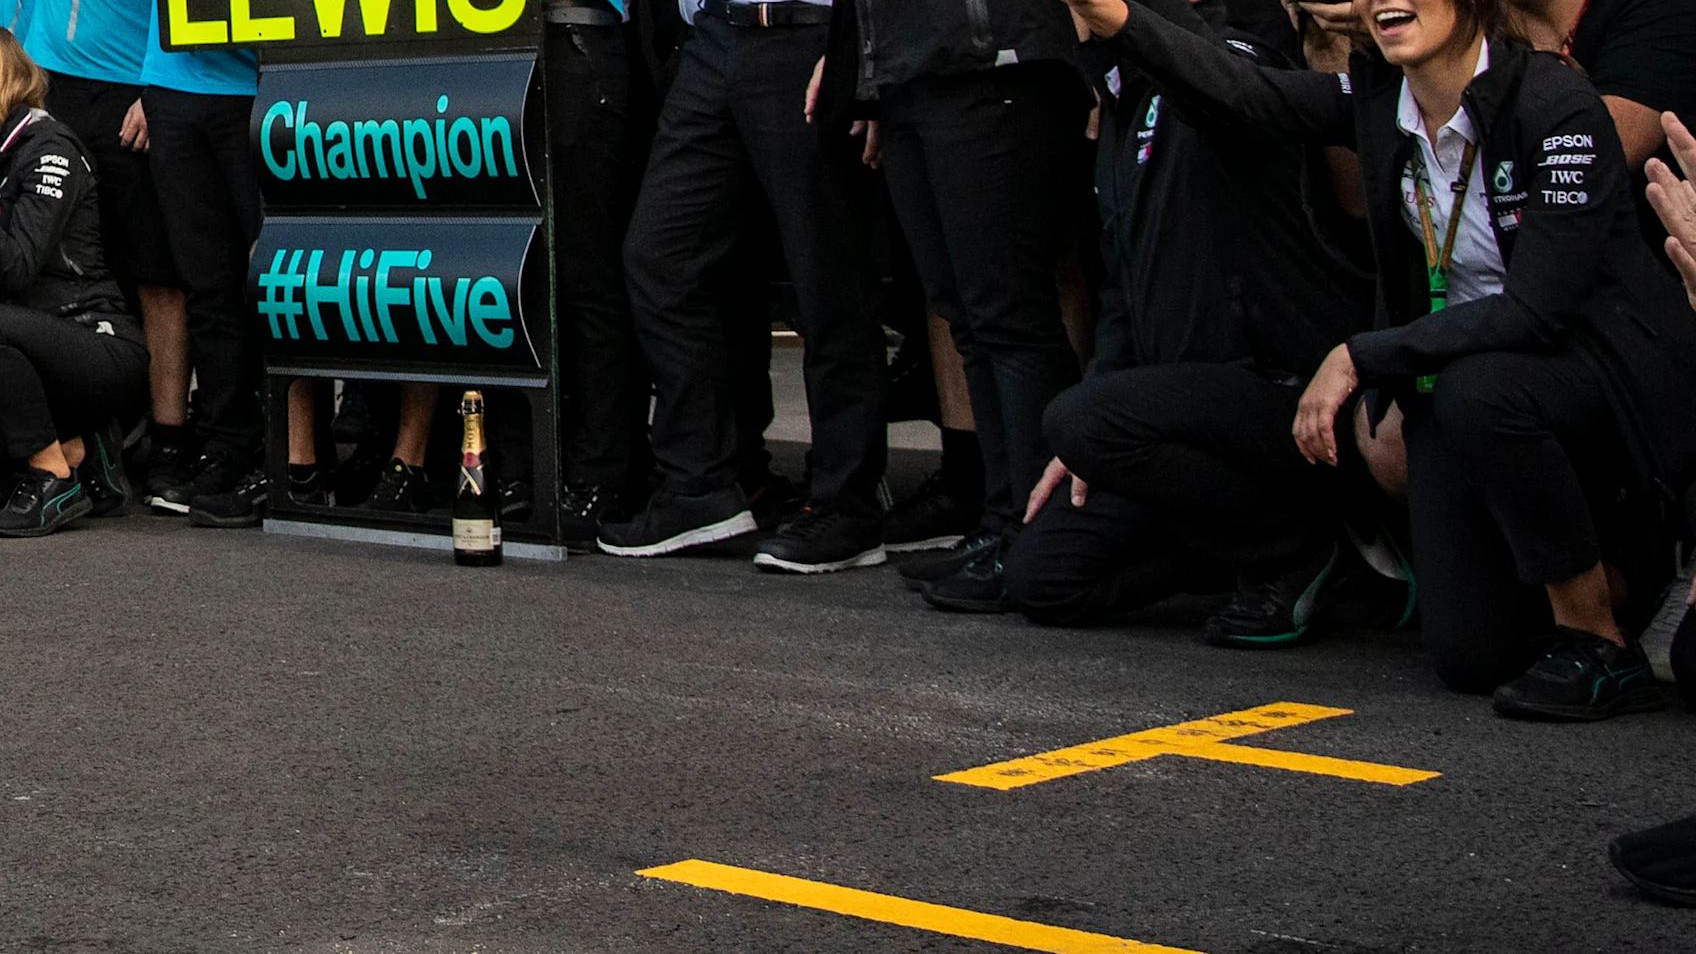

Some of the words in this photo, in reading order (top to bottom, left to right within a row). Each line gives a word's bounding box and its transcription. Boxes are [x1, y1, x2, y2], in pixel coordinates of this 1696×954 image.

[261, 95, 518, 199] Champion
[1542, 133, 1594, 151] EPSON
[40, 153, 69, 168] EPSON
[1537, 153, 1596, 166] BOSE
[42, 174, 62, 186] IWC
[1550, 170, 1584, 184] IWC
[35, 184, 63, 199] TIBCO
[1541, 190, 1588, 205] TIBCO
[257, 249, 515, 349] #HiFive
